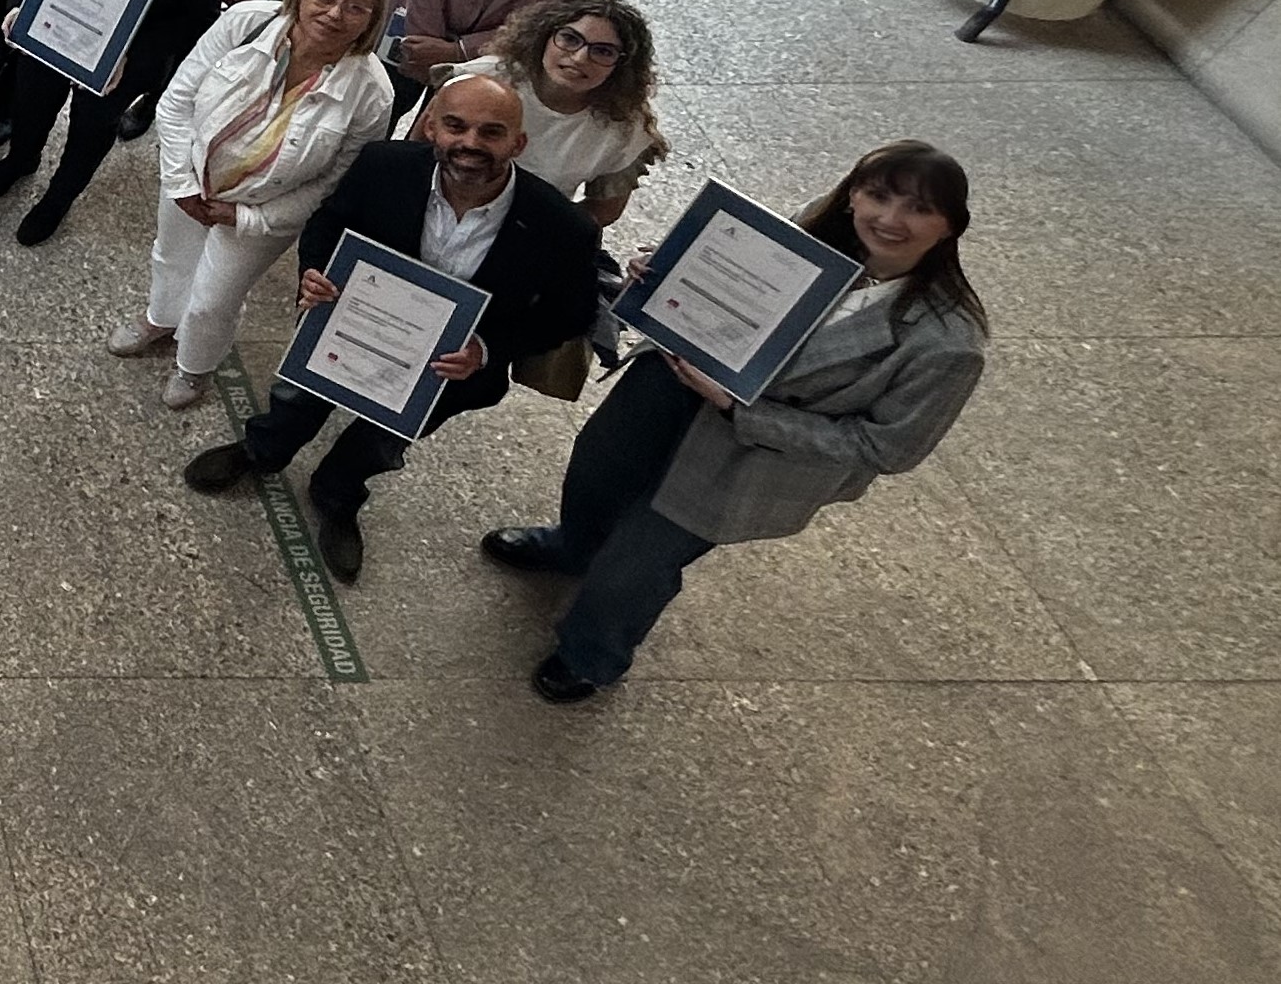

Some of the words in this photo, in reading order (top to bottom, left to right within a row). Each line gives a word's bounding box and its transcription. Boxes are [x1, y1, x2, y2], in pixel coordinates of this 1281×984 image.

[260, 472, 304, 541] STANCIA
[291, 544, 313, 573] DE
[298, 572, 358, 674] SEGURIDAD
